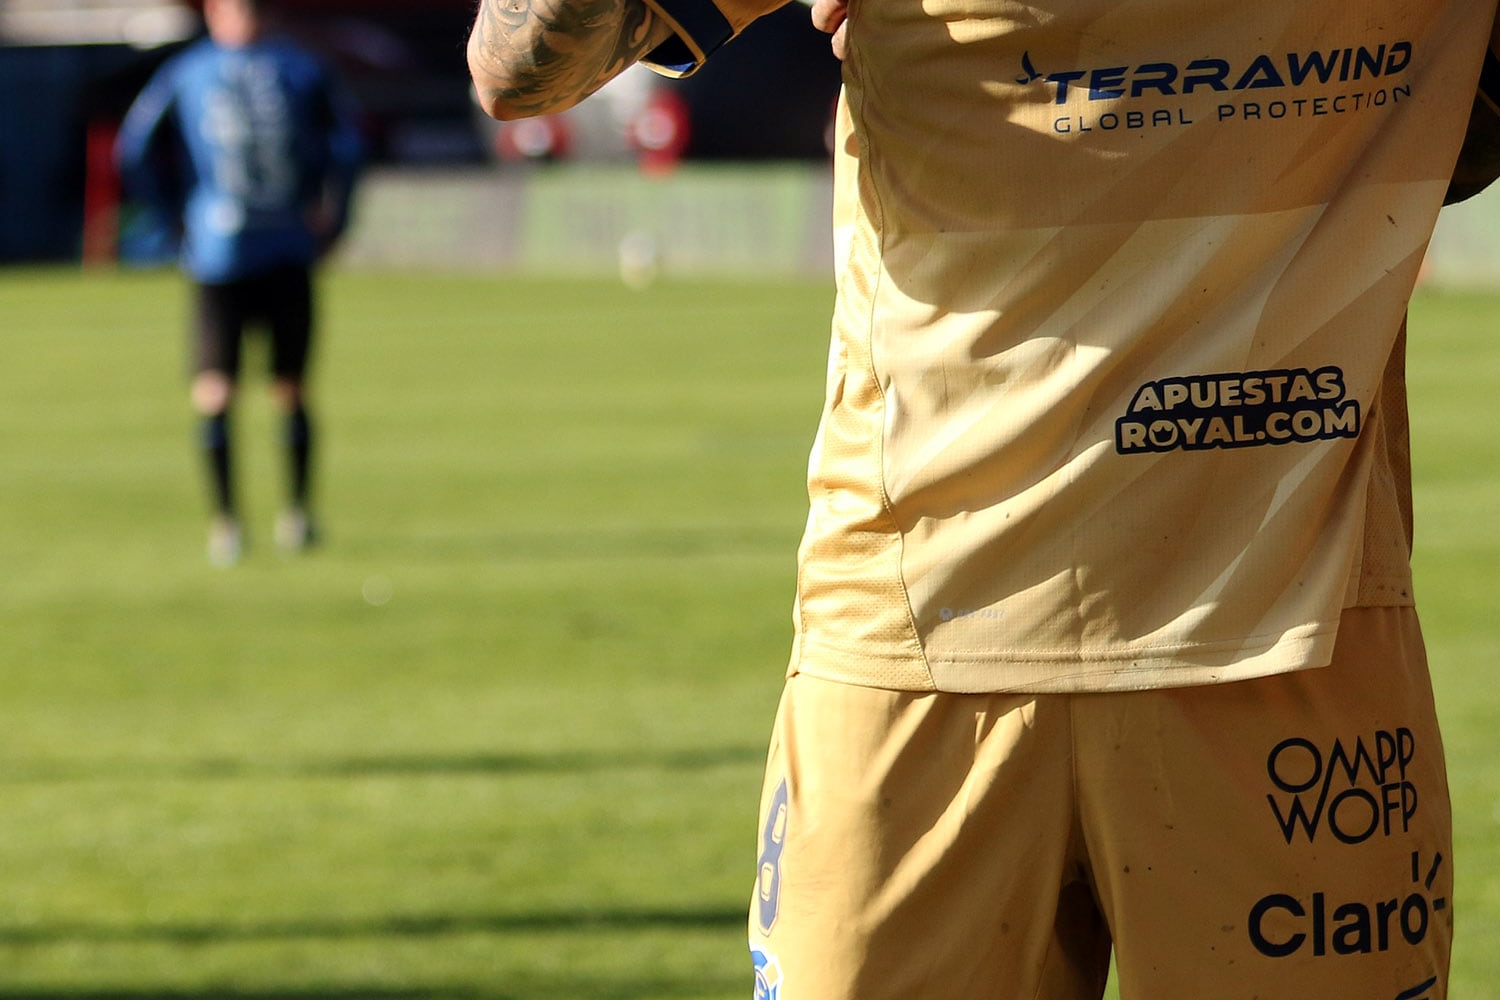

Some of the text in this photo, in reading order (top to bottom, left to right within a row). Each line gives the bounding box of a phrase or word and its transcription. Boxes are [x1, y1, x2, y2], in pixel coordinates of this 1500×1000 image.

[1044, 41, 1412, 105] TERRAWIND
[1054, 83, 1412, 133] GLOBAL PROTECTION
[1132, 372, 1341, 413] APUESTAS
[1121, 405, 1356, 449] ROYAL.COM
[1248, 892, 1429, 958] Claro
